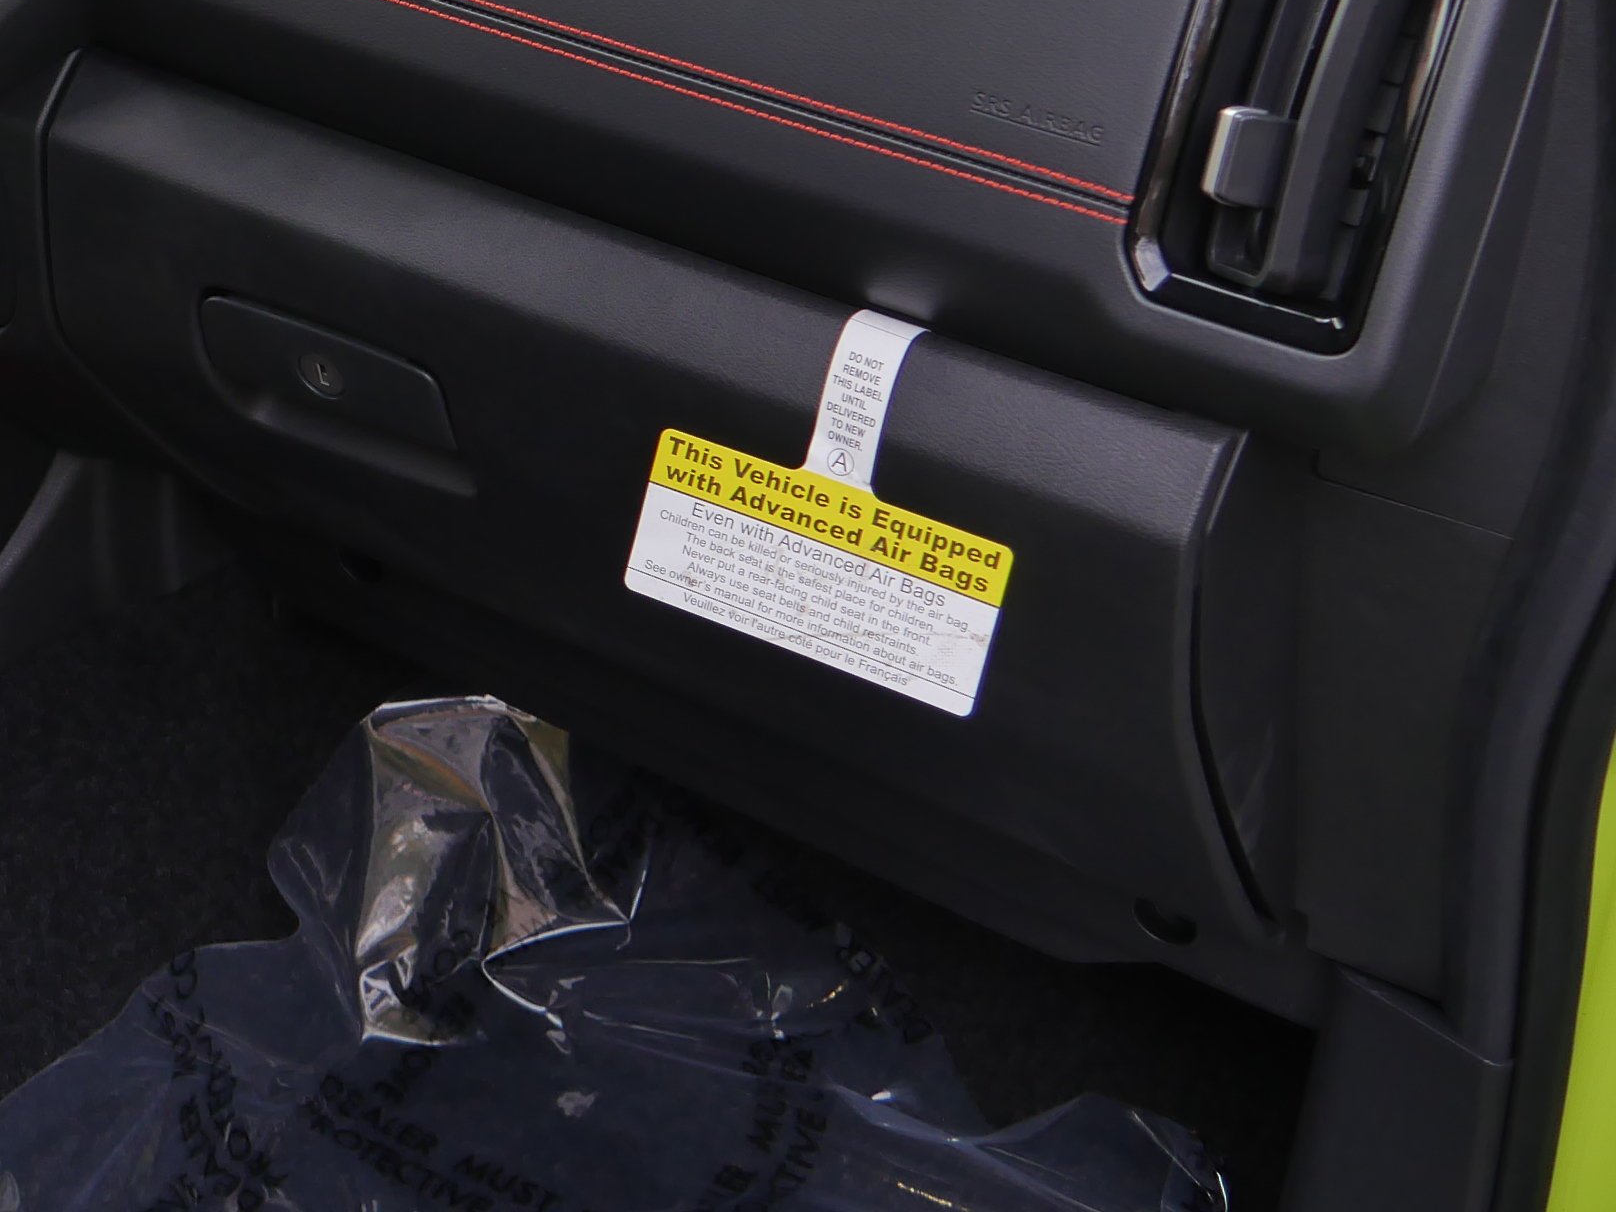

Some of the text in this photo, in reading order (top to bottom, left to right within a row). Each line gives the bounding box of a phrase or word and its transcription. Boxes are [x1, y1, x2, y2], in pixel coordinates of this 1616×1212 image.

[833, 375, 883, 402] THIS LABEL
[843, 364, 882, 386] REMOVE
[849, 351, 884, 372] DO NOT
[826, 402, 876, 428] DELIVERED
[832, 417, 866, 437] TO NEW
[842, 394, 867, 410] UNTIL
[828, 430, 863, 451] OWNER.
[666, 465, 989, 592] with Advanced Air Bags
[669, 436, 1001, 570] This Vehicle is Equipped
[661, 509, 705, 534] Children
[708, 528, 728, 542] can
[731, 534, 745, 548] be
[748, 541, 778, 560] killed
[779, 554, 793, 565] or
[794, 558, 846, 586] seriously
[848, 577, 887, 600] injured
[890, 592, 904, 608] by
[907, 599, 927, 614] the
[928, 609, 944, 620] air
[683, 544, 715, 565] Never
[717, 558, 736, 574] put
[738, 567, 746, 577] a
[748, 571, 808, 602] rear-facing
[811, 594, 838, 611] child
[841, 606, 866, 622] seat
[868, 614, 879, 626] in
[882, 619, 900, 634] the
[687, 532, 707, 548] The
[710, 541, 737, 559] back
[739, 551, 763, 570] seat
[765, 561, 775, 573] is
[778, 566, 796, 581] the
[799, 573, 833, 595] safest
[835, 589, 866, 607] place
[870, 599, 886, 613] for
[692, 502, 946, 610] Even with Advanced Air Bags
[645, 559, 667, 575] See
[714, 585, 756, 609] manual
[758, 601, 774, 616] for
[775, 610, 805, 627] more
[807, 619, 871, 652] information
[873, 646, 907, 666] about
[909, 660, 925, 672] air
[684, 592, 726, 617] Veuillez
[729, 610, 750, 625] voir
[815, 644, 843, 660] pour
[845, 653, 856, 666] le
[687, 561, 727, 588] Always
[730, 578, 750, 592] use
[752, 587, 777, 603] seat
[779, 594, 807, 614] belts
[809, 608, 832, 623] and
[833, 617, 861, 635] child
